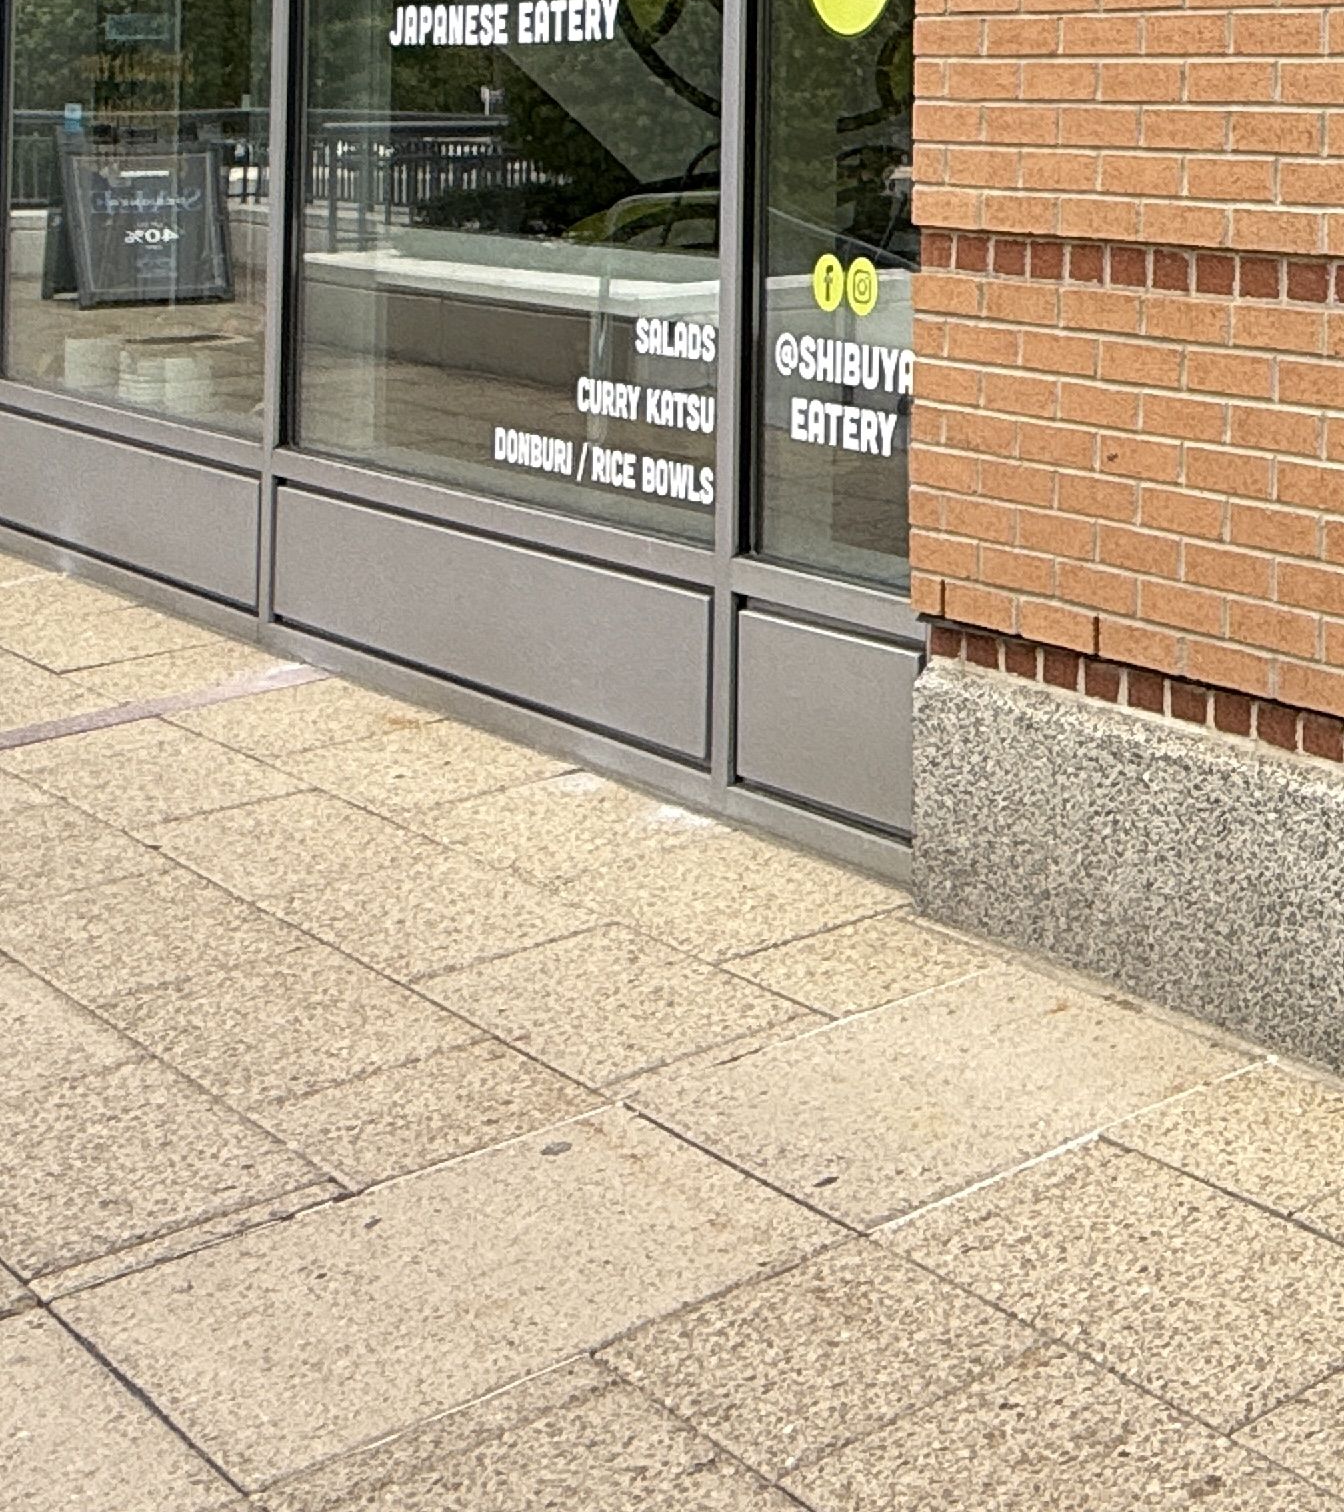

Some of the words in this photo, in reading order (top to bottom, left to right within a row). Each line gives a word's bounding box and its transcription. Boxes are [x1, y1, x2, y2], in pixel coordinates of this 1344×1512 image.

[389, 3, 509, 47] JAPANESE
[634, 317, 716, 363] SALADS
[774, 331, 914, 396] @SHIBUYA
[576, 376, 642, 421] CURRY
[646, 387, 715, 434] KATSU
[789, 396, 898, 459] EATERY
[493, 426, 572, 477] DONBURI
[592, 446, 636, 491] RICE
[641, 456, 715, 506] BOWLS
